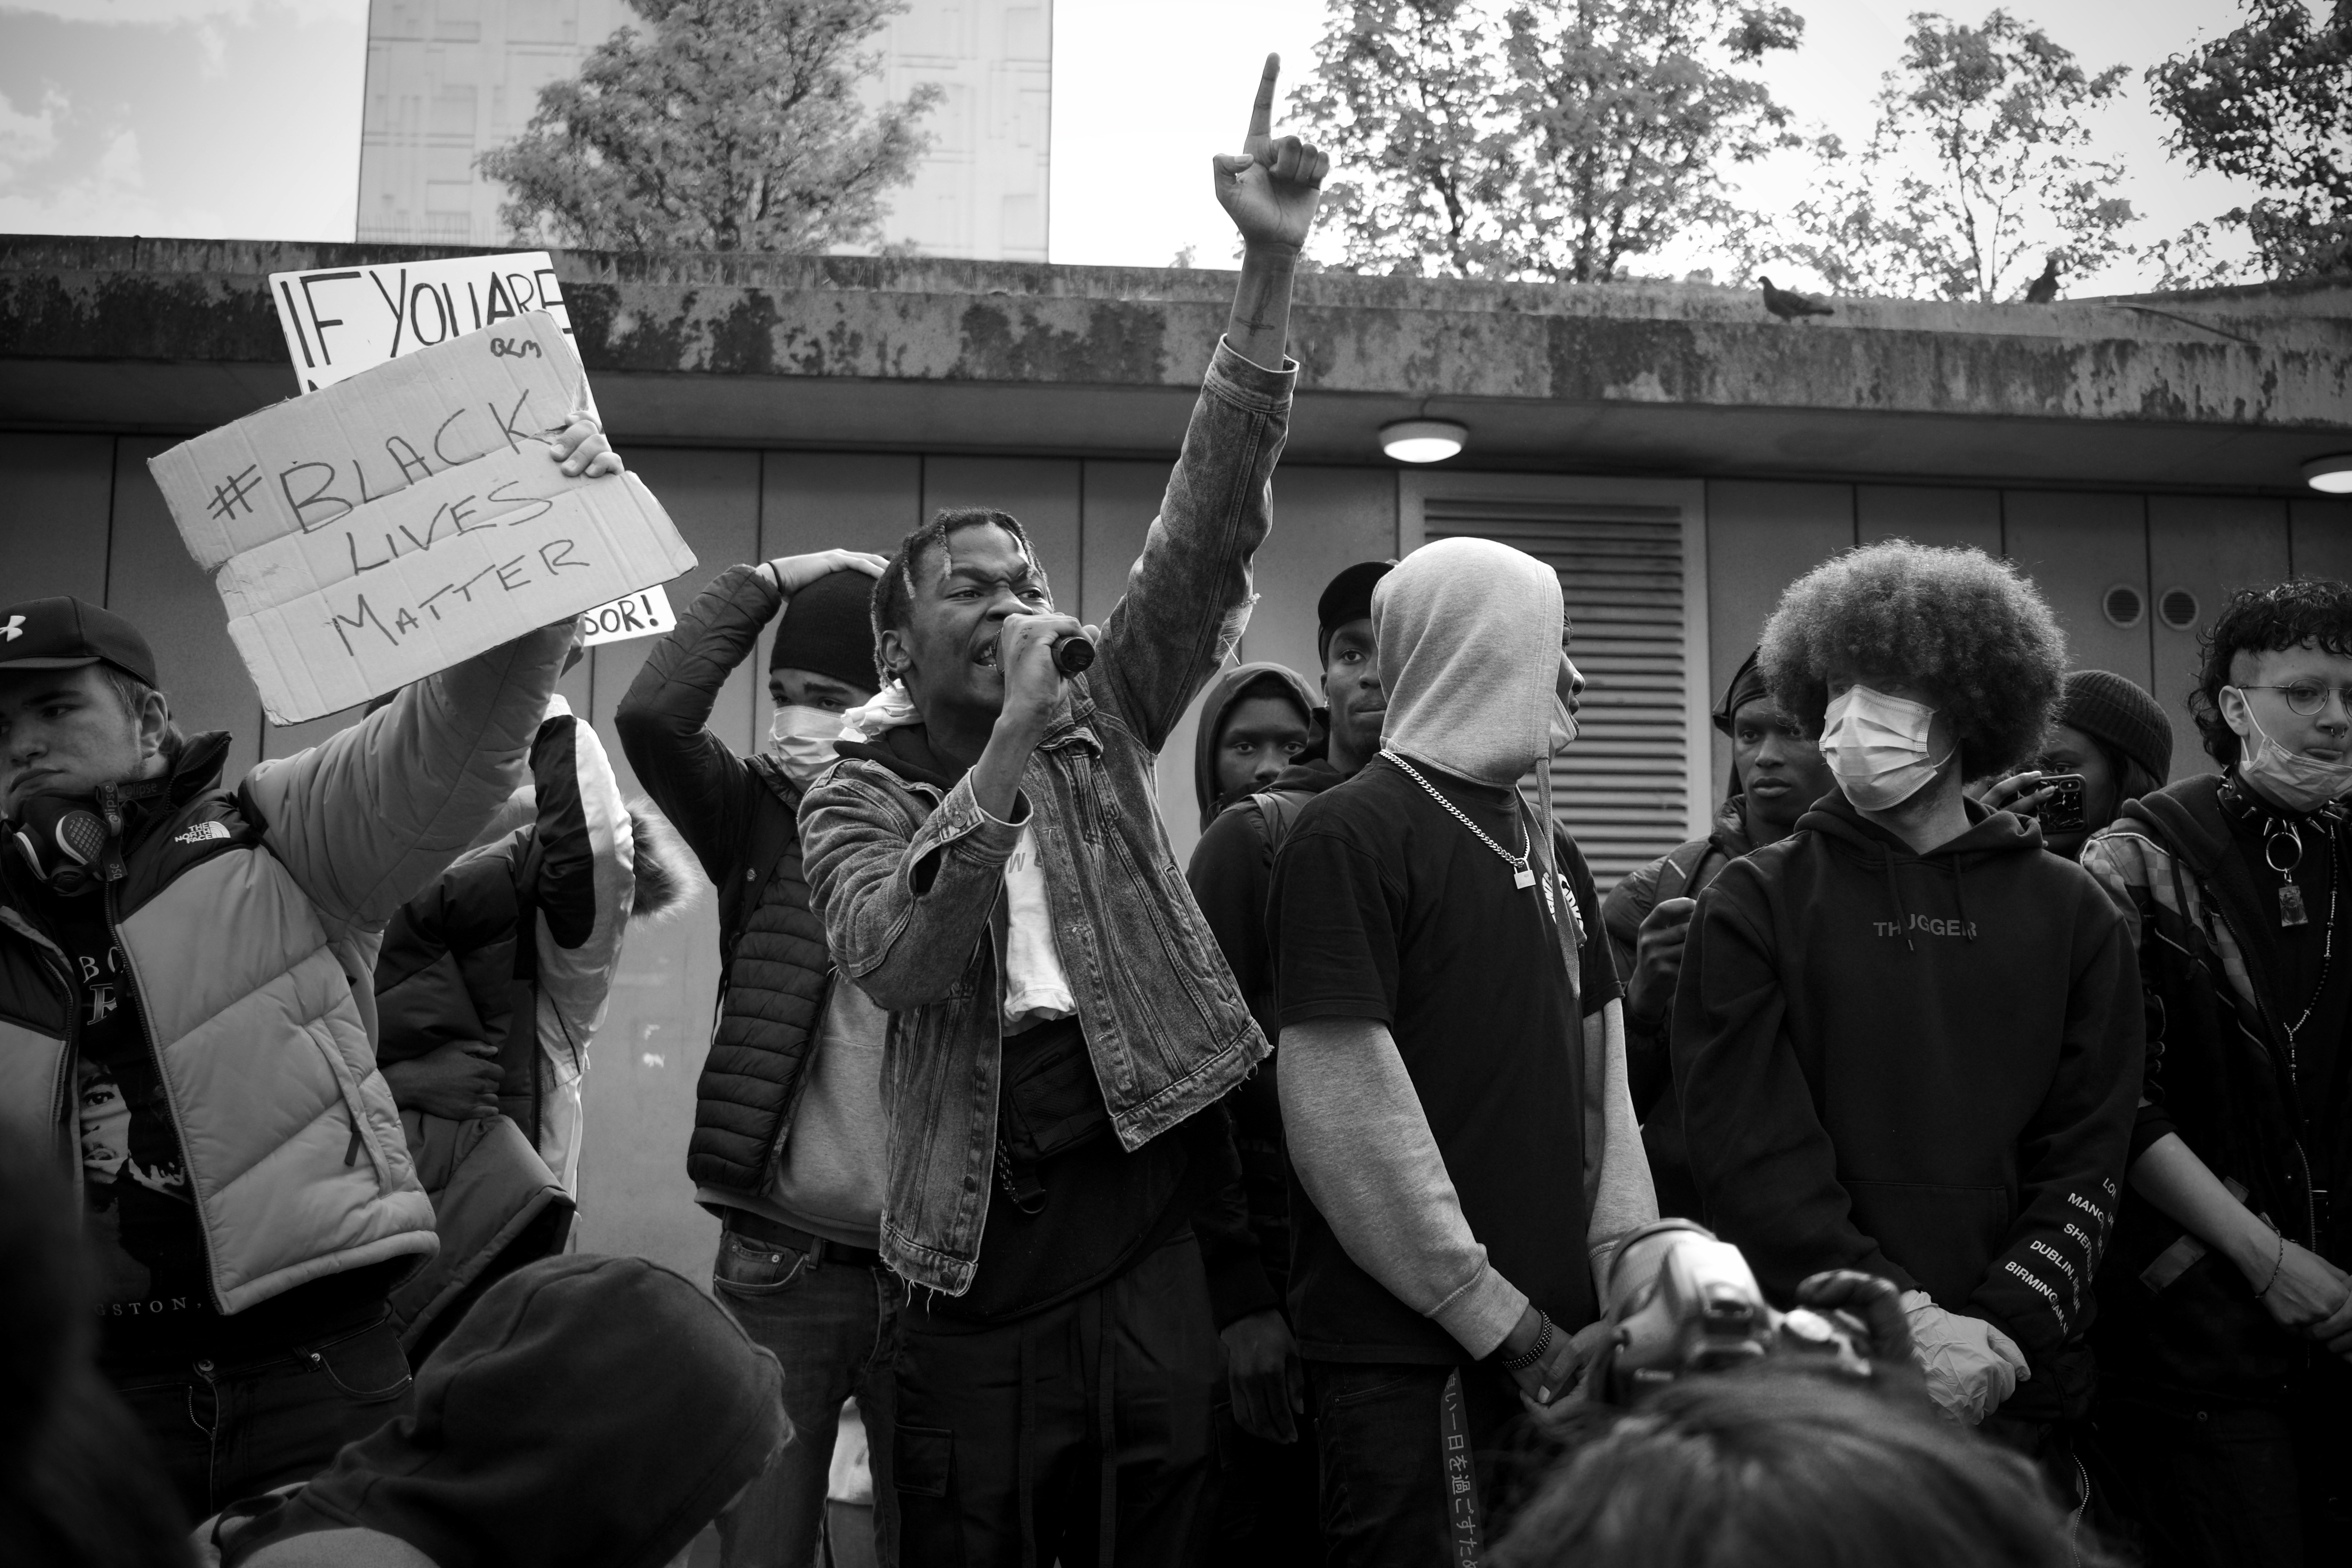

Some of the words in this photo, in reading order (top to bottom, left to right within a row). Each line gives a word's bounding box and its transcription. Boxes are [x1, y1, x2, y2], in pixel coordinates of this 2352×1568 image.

[279, 271, 361, 368] IF
[369, 269, 482, 358] YOU
[208, 388, 553, 534] #BLACK
[347, 481, 553, 575] LIVES
[331, 539, 590, 657] MATTER
[174, 828, 211, 842] NORTH
[186, 833, 213, 844] FACE
[188, 822, 210, 832] THE
[2030, 1240, 2075, 1280] DUBLIN,
